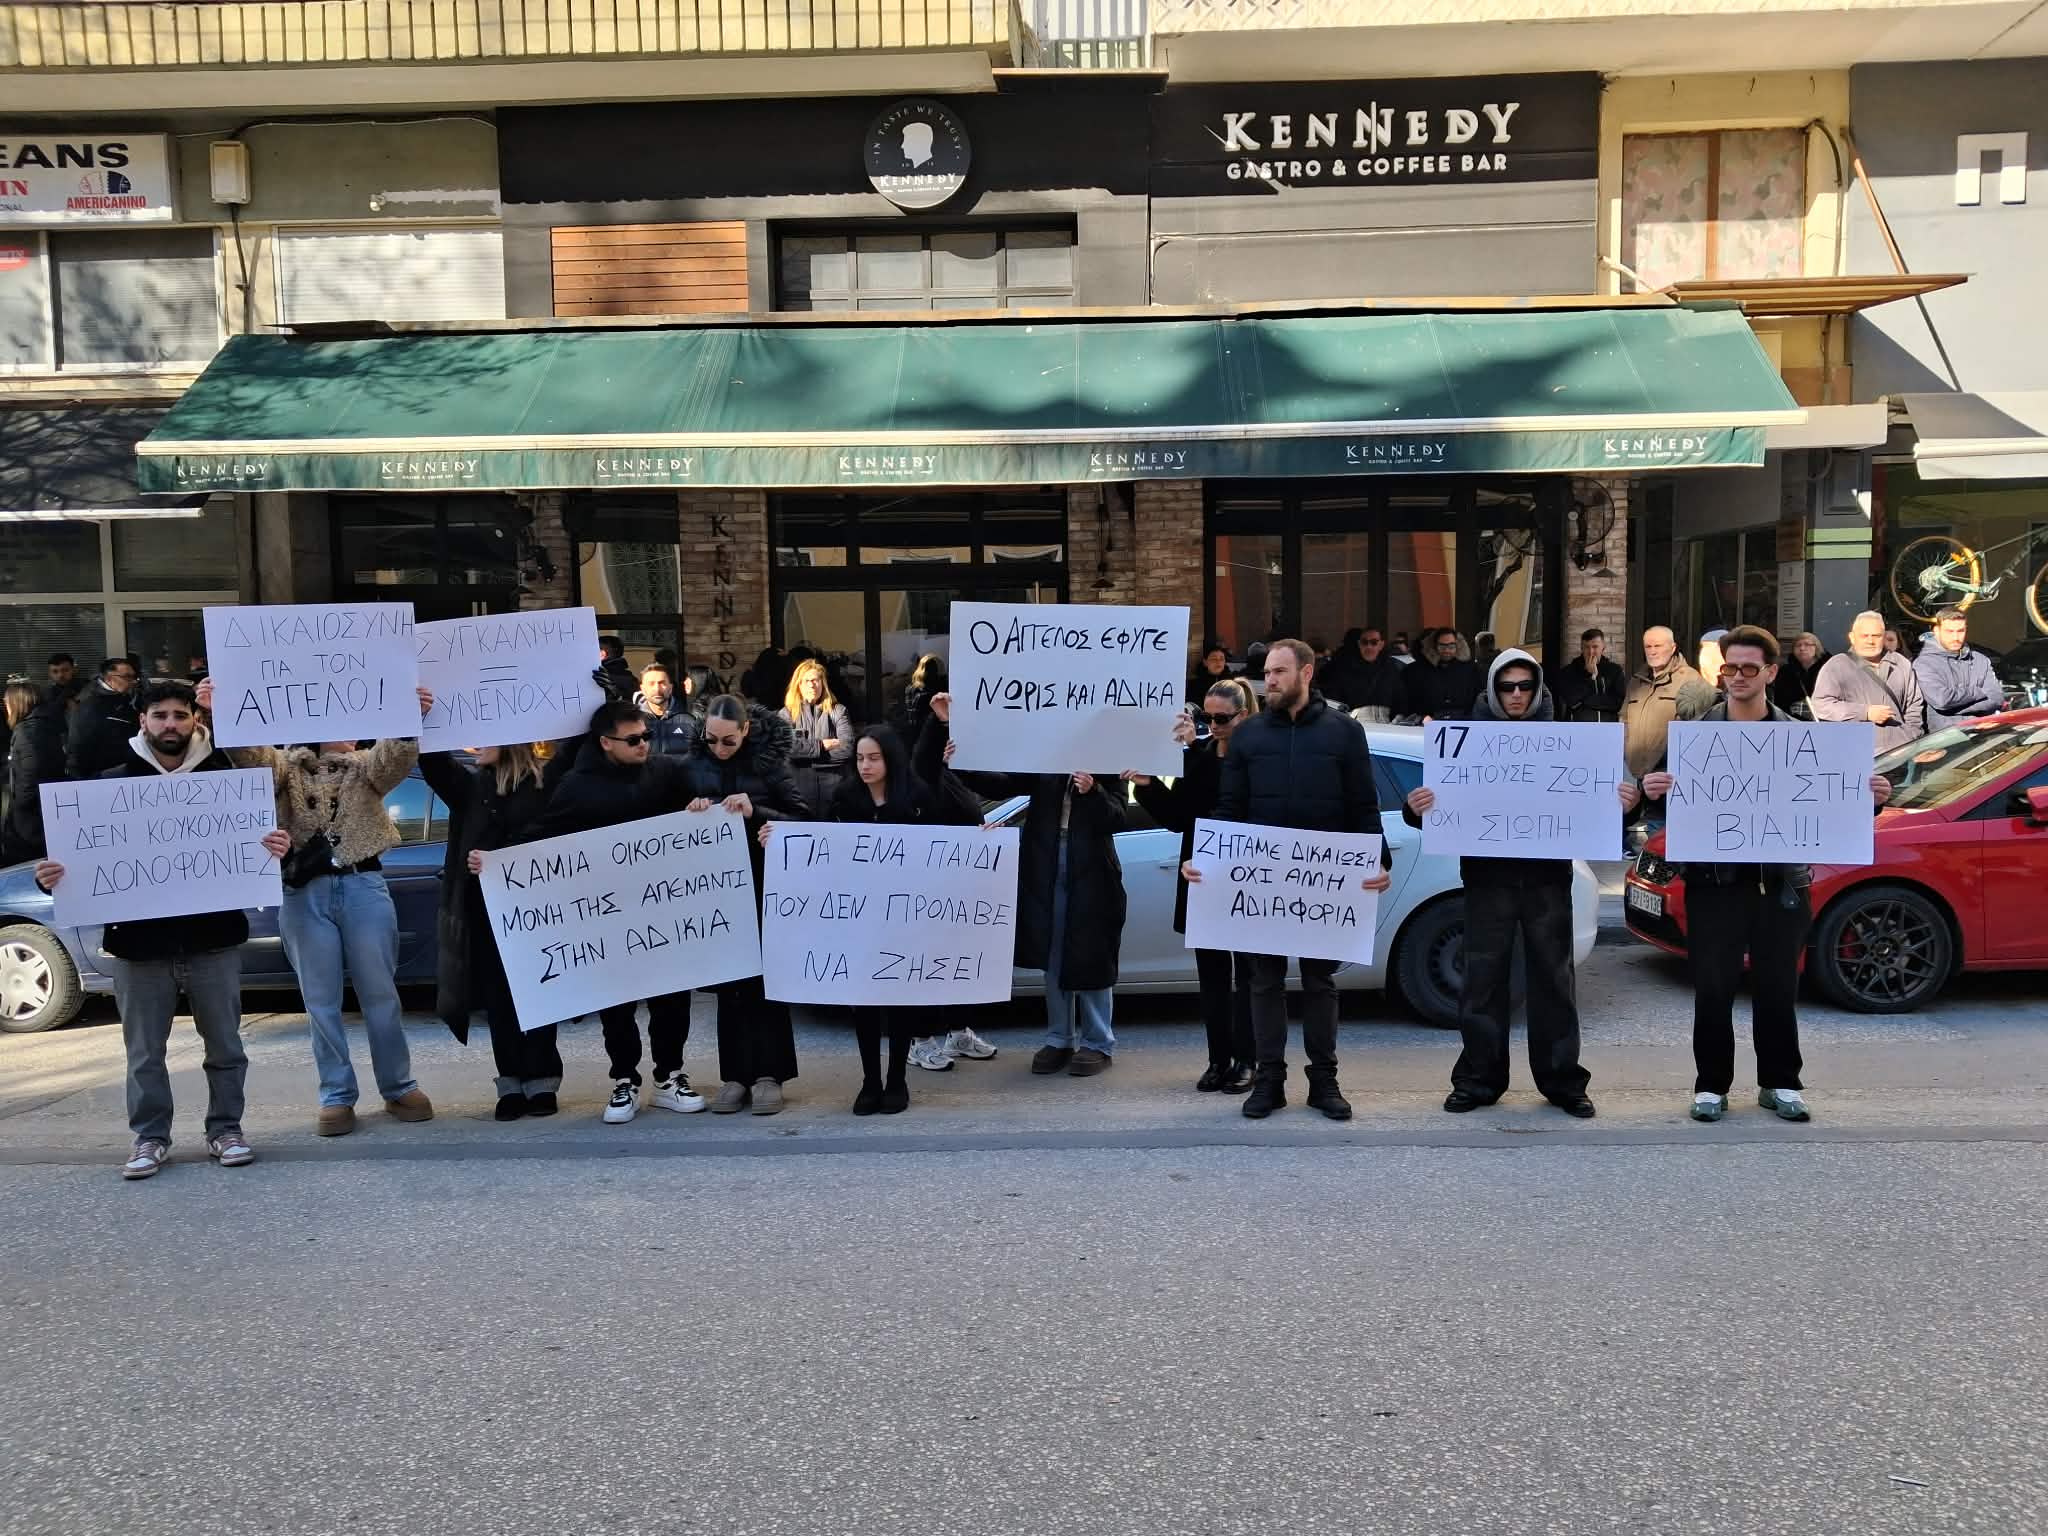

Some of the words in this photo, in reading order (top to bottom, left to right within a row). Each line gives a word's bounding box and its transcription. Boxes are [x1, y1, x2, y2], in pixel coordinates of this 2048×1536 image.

[1223, 101, 1520, 154] KENNEDY
[0, 142, 129, 169] ANS
[1226, 159, 1321, 179] GASTRO
[1332, 159, 1346, 176] &
[1357, 155, 1450, 176] COFFEE
[1461, 153, 1507, 171] BAR
[880, 172, 956, 187] KENNEDY
[67, 195, 147, 209] AMERICANINO
[1091, 450, 1187, 466] KENNEDY
[1346, 441, 1446, 458] KENNEDY
[1605, 435, 1707, 452] KENNEDY
[178, 463, 267, 478] KENNEDY
[382, 459, 478, 474] KENNEDY
[597, 458, 693, 472] KENNEDY
[839, 456, 936, 470] KENNEDY
[711, 515, 737, 695] KENNEDY
[224, 609, 414, 648] ΔΙΚΑΙΟΣΥΝΗ
[970, 620, 999, 654] Ο
[1003, 616, 1092, 655] ΑΓΓΕΛΟΣ
[1100, 626, 1169, 654] ΕΦΥΓΕ
[312, 650, 366, 674] ΤΟΝ
[976, 676, 1059, 713] ΝΩΡΙΣ
[1066, 680, 1096, 711] ΚΑΙ
[1104, 677, 1174, 709] ΑΔΙΚΑ
[1433, 726, 1470, 759] 17
[1480, 734, 1573, 758] ΧΡΟΝΩΝ
[1677, 728, 1819, 776] ΚΑΜΙΑ
[1440, 764, 1537, 785] ΖΗΤΟΥΣΕ
[1546, 765, 1616, 794] ΖΩΗ
[1669, 773, 1771, 806] ΑΝΟΧΗ
[1791, 771, 1862, 802] ΣΤΗ
[54, 788, 81, 820] Η
[110, 775, 266, 814] ΔΙΚΑΙΟΣΥΝΗ
[76, 823, 128, 851] ΔΕΝ
[1430, 808, 1461, 827] ΟΧΙ
[1477, 813, 1573, 842] ΣΙΩΠΗ
[501, 850, 591, 890] ΚΑΜΙΑ
[611, 822, 734, 866] ΟΙΚΟΓΕΝΕΙΑ
[784, 834, 830, 871] ΓΙΑ
[852, 835, 905, 867] ΕΝΑ
[926, 840, 1002, 872] ΠΑΙΔΙ
[1197, 828, 1284, 861] ΖΗΤΑΜΕ
[1291, 840, 1377, 870] ΔΙΚΑΙΩΣΗ
[1230, 866, 1273, 884] ΟΧΙ
[1285, 867, 1346, 892] ΑΛΛΗ
[502, 903, 564, 938] ΜΟΝΗ
[570, 891, 623, 921] ΤΗΣ
[641, 869, 748, 907] ΑΠΕΝΑΝΤΙ
[764, 892, 810, 919] ΠΟΥ
[819, 891, 867, 920] ΔΕΝ
[886, 893, 1011, 926] ΠΡΟΛΑΒΕ
[1231, 889, 1356, 928] ΑΔΙΑΦΟΡΙΑ
[540, 937, 608, 983] ΣΤΗΝ
[626, 908, 731, 956] ΑΔΙΚΙΑ
[804, 950, 849, 982] ΝΑ
[872, 951, 983, 982] ΖΗΣΕΙ
